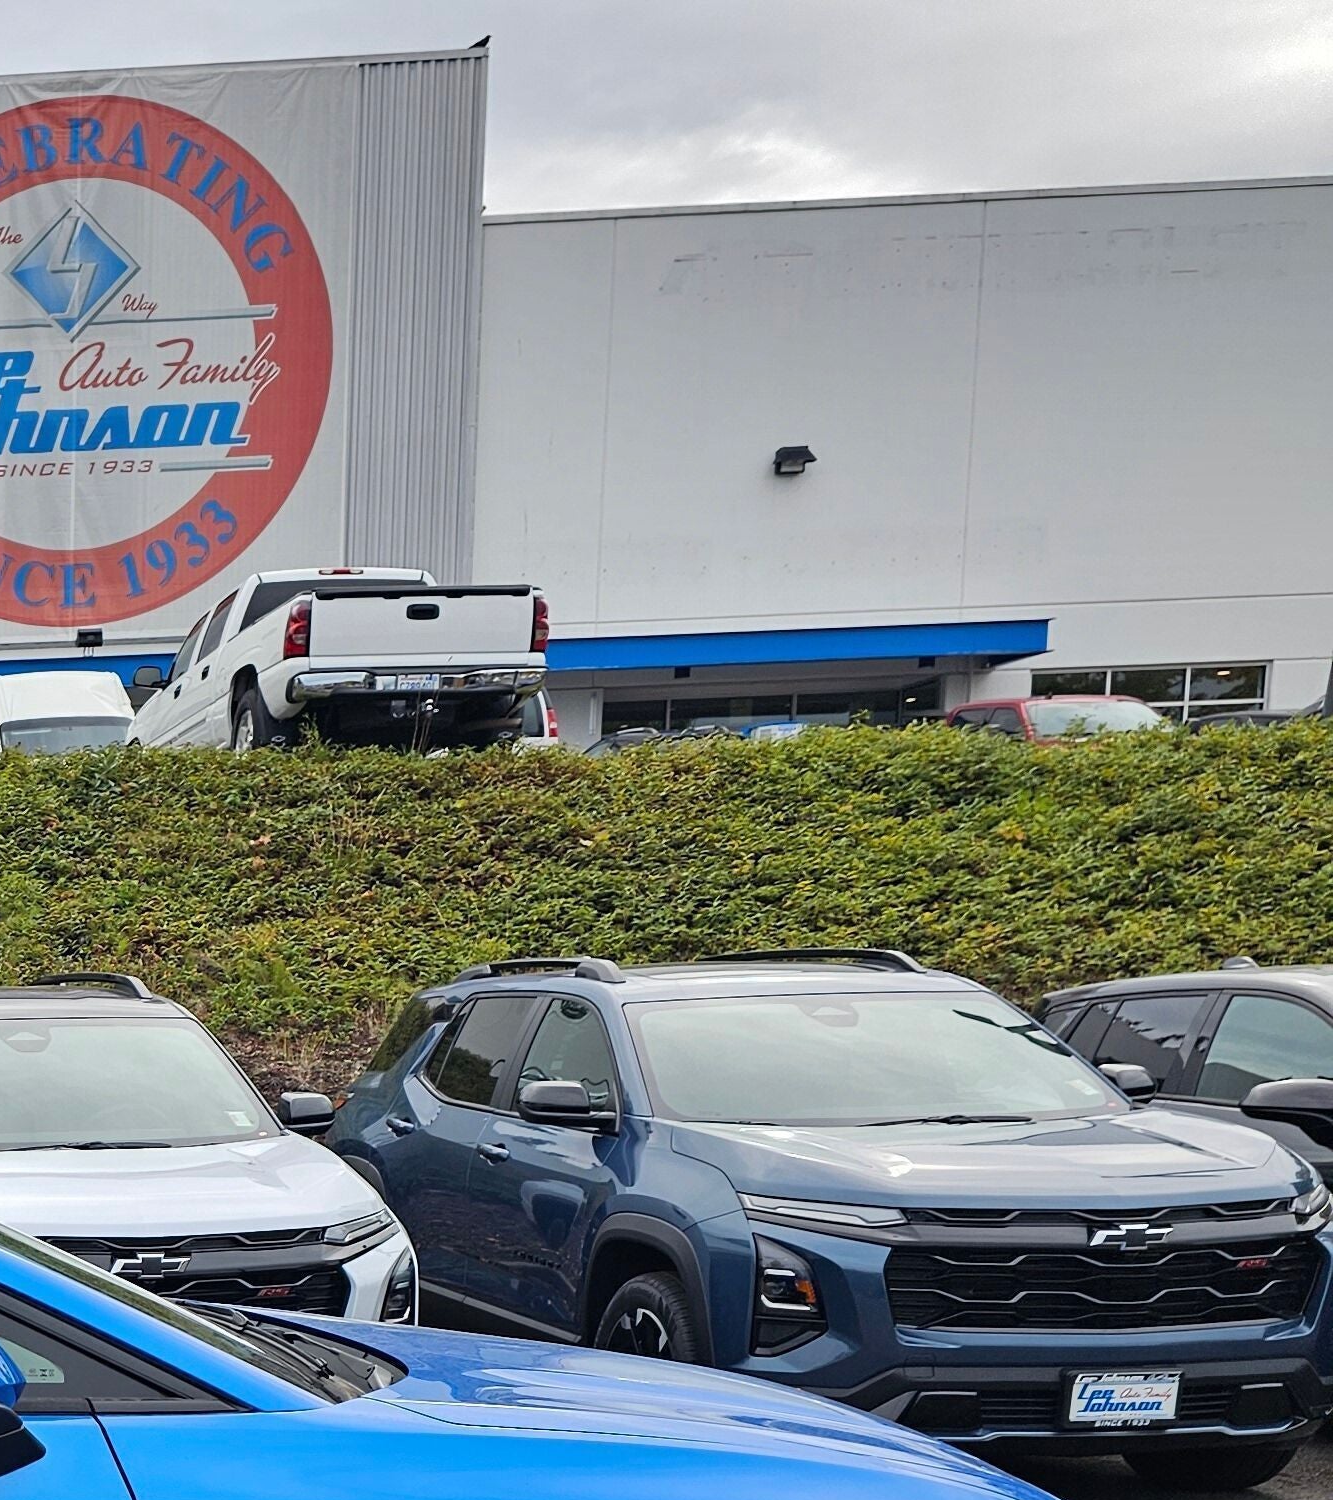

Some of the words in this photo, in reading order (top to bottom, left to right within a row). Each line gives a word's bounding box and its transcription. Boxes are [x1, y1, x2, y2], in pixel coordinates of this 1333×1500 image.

[122, 293, 158, 318] Way
[59, 341, 149, 393] Auto
[155, 332, 281, 404] Family
[87, 459, 153, 476] 1933
[117, 499, 239, 600] 1933
[1077, 1384, 1115, 1400] Lee
[1076, 1397, 1163, 1413] Johnson
